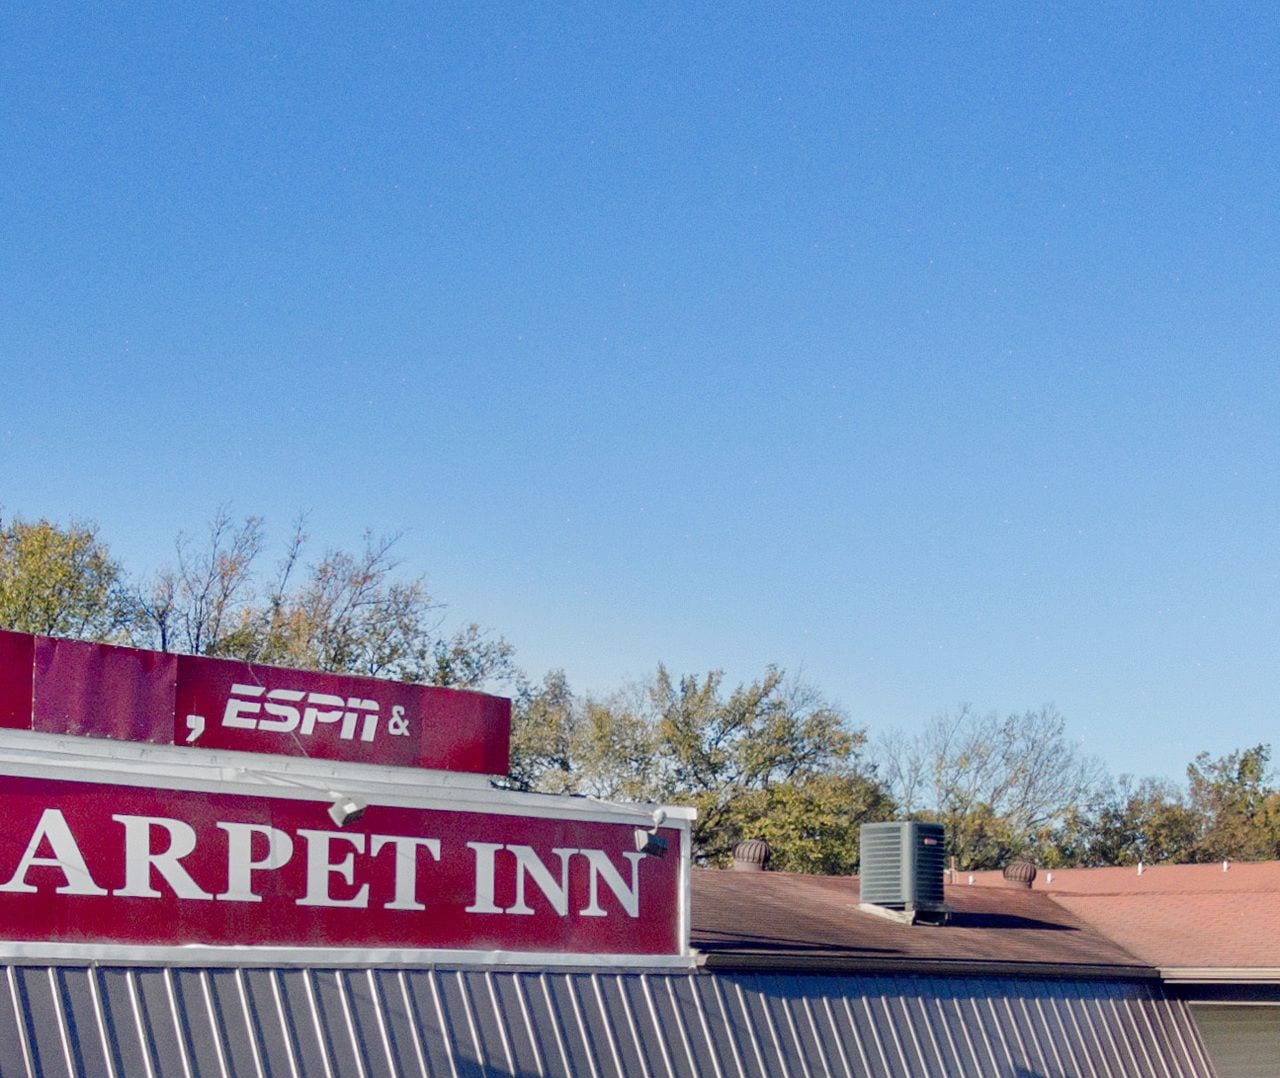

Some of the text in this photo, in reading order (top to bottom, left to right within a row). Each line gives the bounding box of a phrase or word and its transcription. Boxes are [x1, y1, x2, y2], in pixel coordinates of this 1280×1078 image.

[221, 683, 380, 744] ESPN
[388, 705, 410, 737] &
[465, 841, 647, 919] INN
